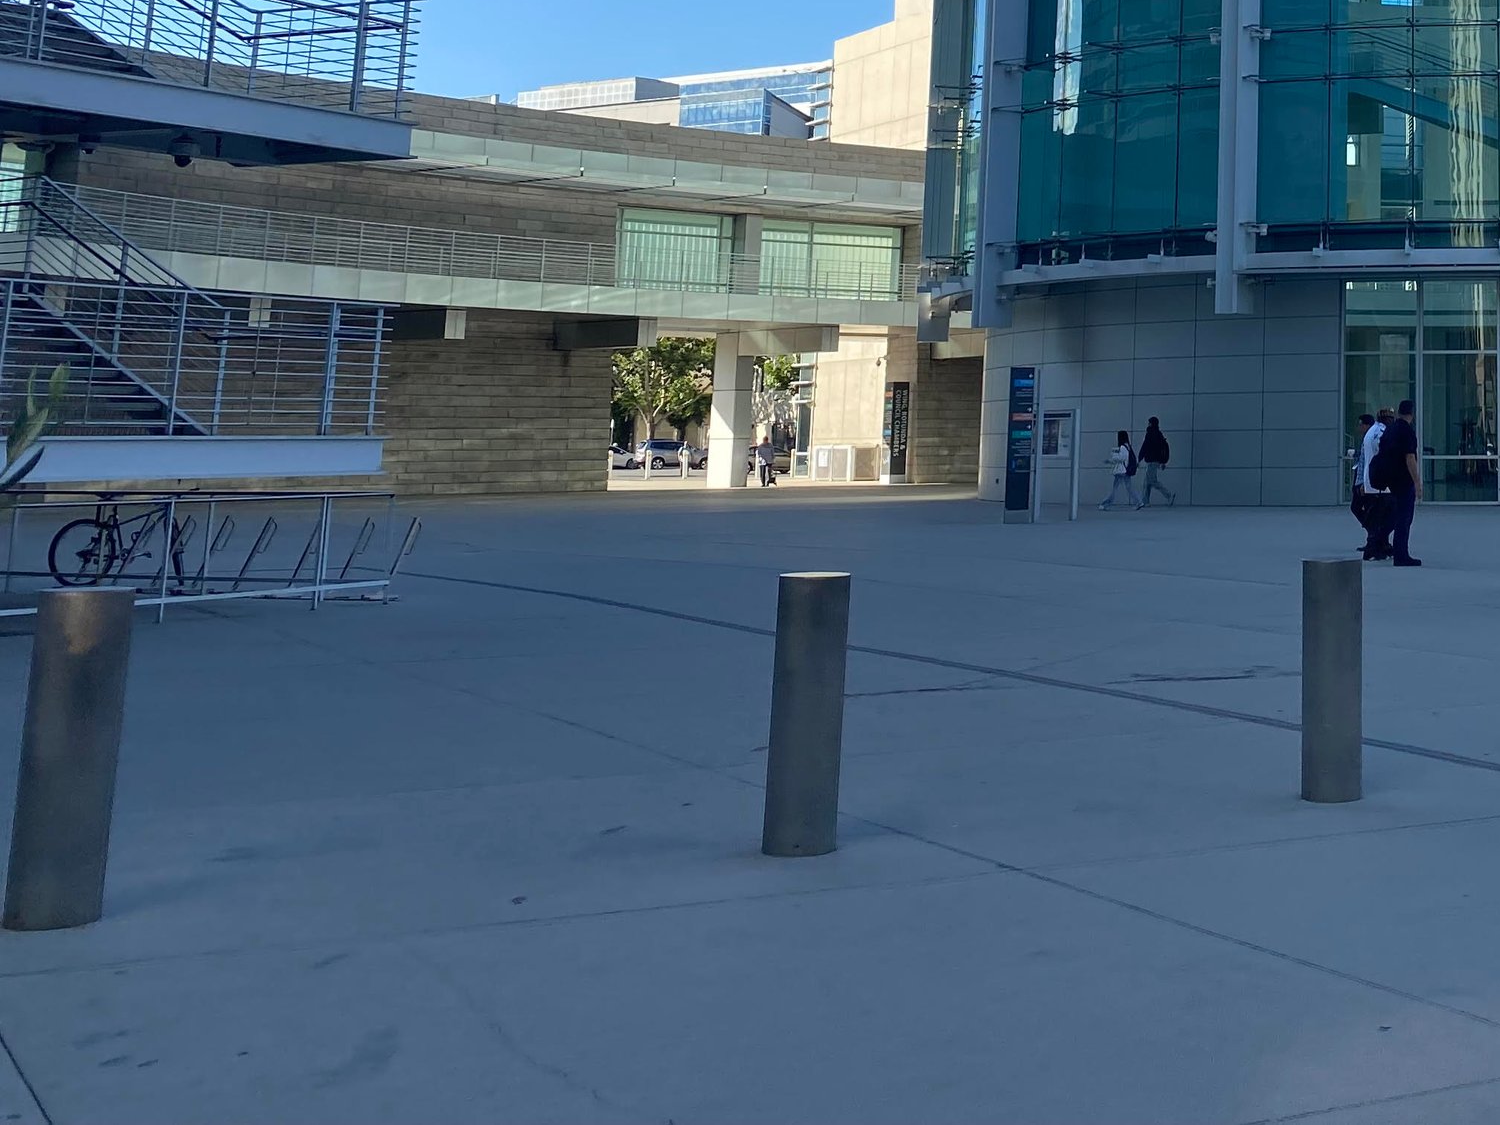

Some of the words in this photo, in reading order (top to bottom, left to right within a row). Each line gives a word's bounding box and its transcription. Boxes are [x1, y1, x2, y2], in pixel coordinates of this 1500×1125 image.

[894, 389, 902, 419] COUNCIL
[893, 420, 901, 457] CHAMBERS
[900, 411, 908, 443] ROTUNDA
